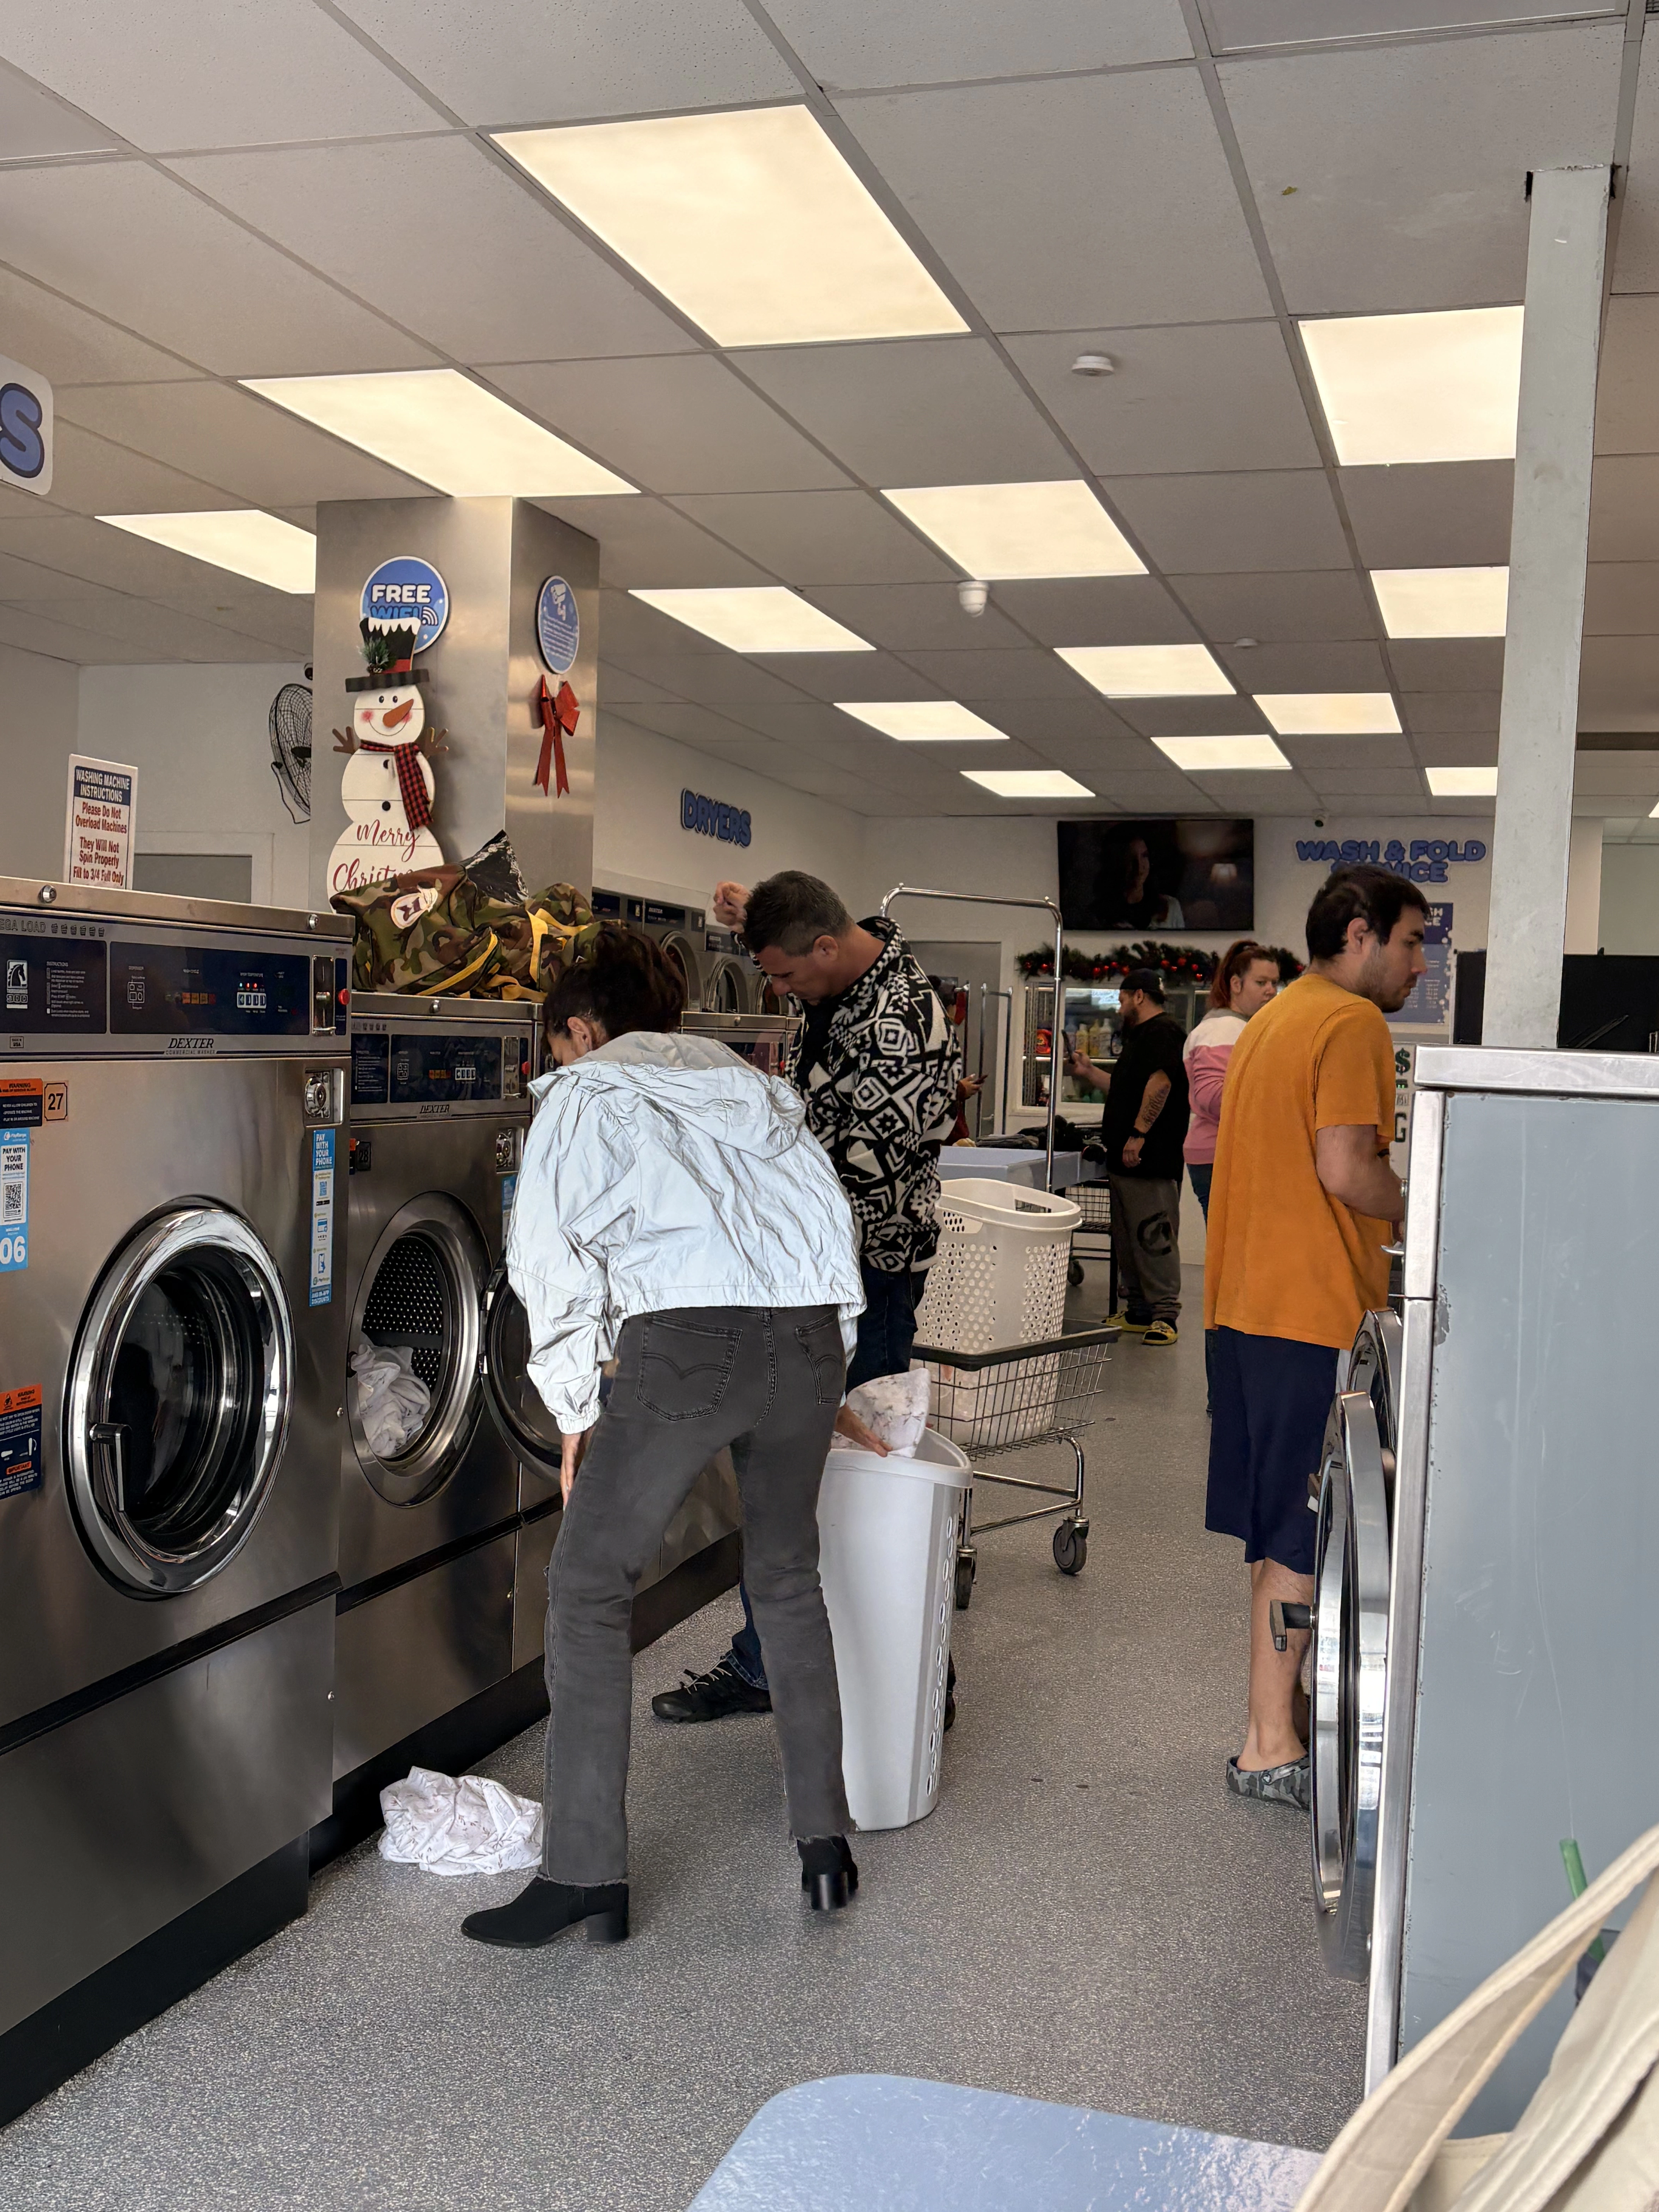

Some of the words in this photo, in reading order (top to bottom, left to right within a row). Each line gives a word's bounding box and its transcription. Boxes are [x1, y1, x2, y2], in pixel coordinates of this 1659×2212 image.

[371, 584, 432, 603] FREE
[76, 769, 103, 785] WASHING
[104, 775, 130, 790] MACHINE
[80, 784, 122, 802] INSTRUCTIONS
[82, 802, 101, 816] Please
[102, 805, 110, 818] Do
[111, 807, 121, 819] Not
[681, 788, 752, 848] DRYERS
[76, 815, 100, 830] Overload
[102, 818, 127, 834] Machines
[80, 836, 94, 852] They
[95, 838, 107, 852] Will
[108, 840, 119, 853] Not
[357, 819, 420, 862] Merry
[79, 850, 93, 865] Spin
[94, 852, 119, 869] Properly
[1295, 840, 1380, 861] WASH
[1384, 840, 1406, 862] &
[1410, 840, 1486, 861] FOLD
[83, 868, 89, 879] to
[91, 869, 100, 881] 3/4
[101, 869, 111, 882] Full
[112, 871, 124, 886] Only
[168, 1038, 214, 1049] DEXTER
[48, 1093, 64, 1110] 27
[316, 1133, 325, 1142] PAY
[316, 1141, 328, 1149] WITH
[316, 1149, 329, 1158] YOUR
[316, 1157, 332, 1166] PHONE
[359, 1150, 369, 1162] 28
[4, 1163, 23, 1171] PHONE
[0, 1236, 26, 1264] 06
